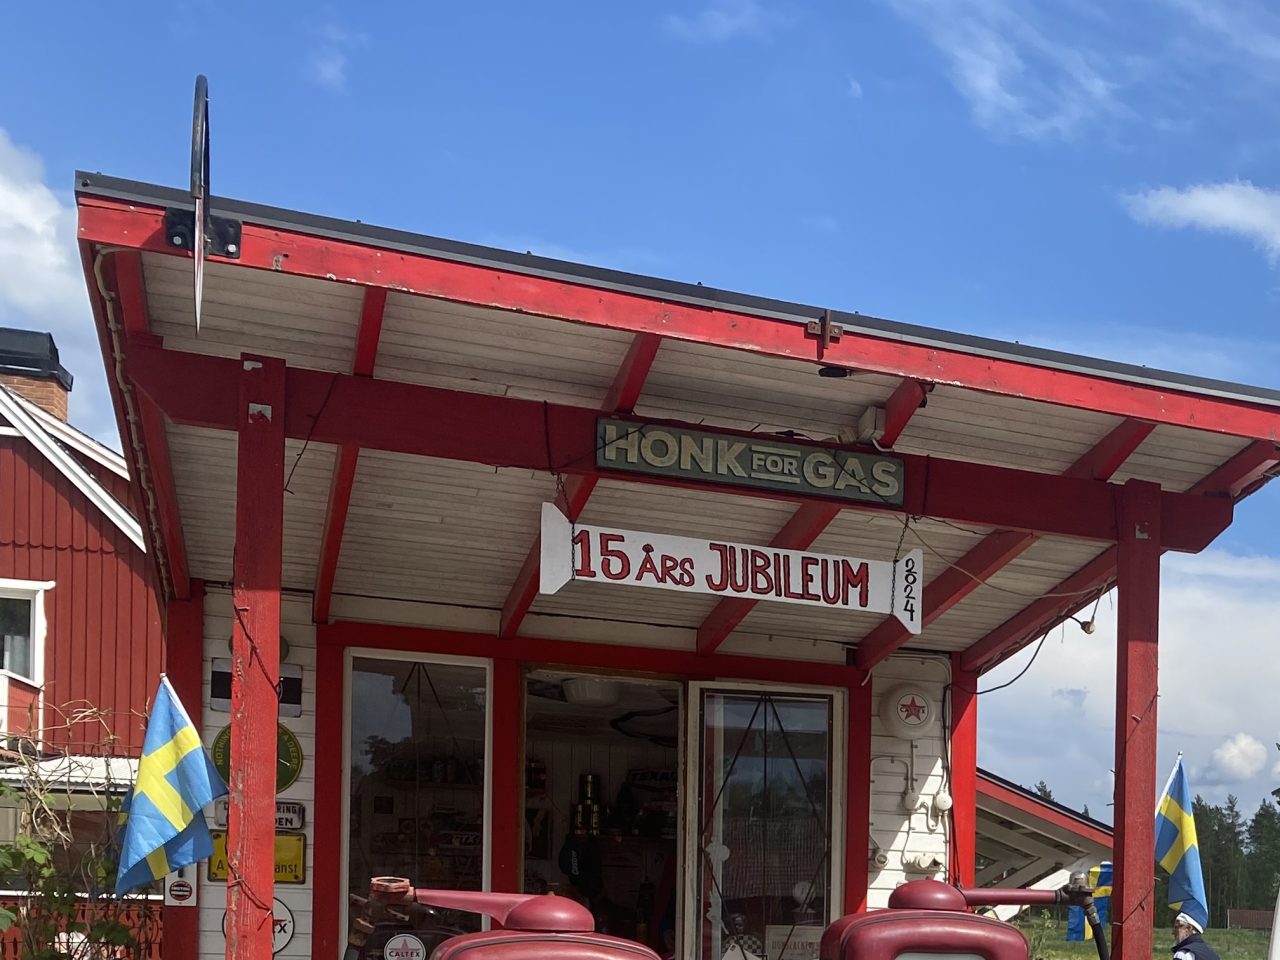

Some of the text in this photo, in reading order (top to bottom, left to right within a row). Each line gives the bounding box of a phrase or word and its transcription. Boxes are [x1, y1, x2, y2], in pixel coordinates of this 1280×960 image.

[604, 424, 900, 497] HONK FOR GAS
[574, 530, 869, 607] 15 ÅRS JUBILEUM
[904, 558, 917, 621] 2024
[388, 950, 421, 958] CALTEX
